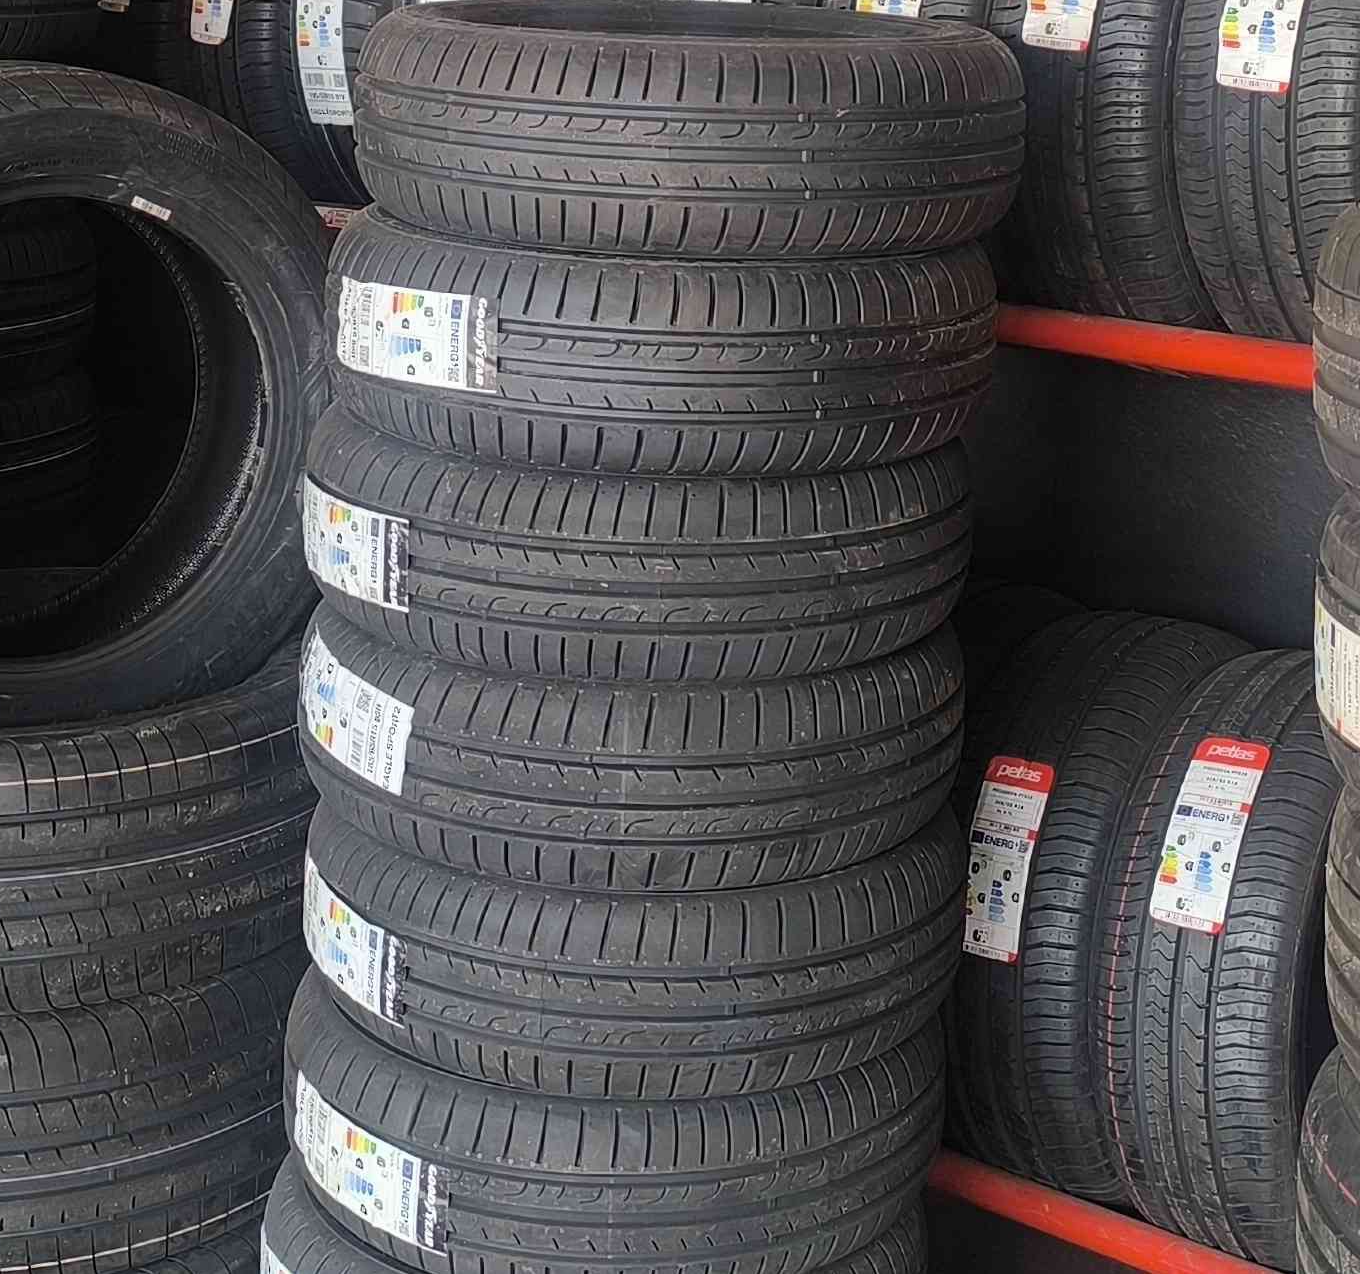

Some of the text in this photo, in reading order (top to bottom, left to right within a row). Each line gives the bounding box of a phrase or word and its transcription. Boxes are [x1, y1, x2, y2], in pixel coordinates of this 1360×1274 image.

[450, 321, 461, 363] ENERG
[475, 297, 488, 386] GOODYEAR
[388, 522, 401, 606] GOODYEAR
[383, 753, 393, 790] EAGLE
[1207, 744, 1258, 761] petlas
[997, 763, 1044, 783] petlas
[1192, 809, 1227, 823] ENERG
[984, 834, 1015, 850] ENERG
[400, 1179, 412, 1220] ENERG
[423, 1164, 438, 1247] GOODYEAR
